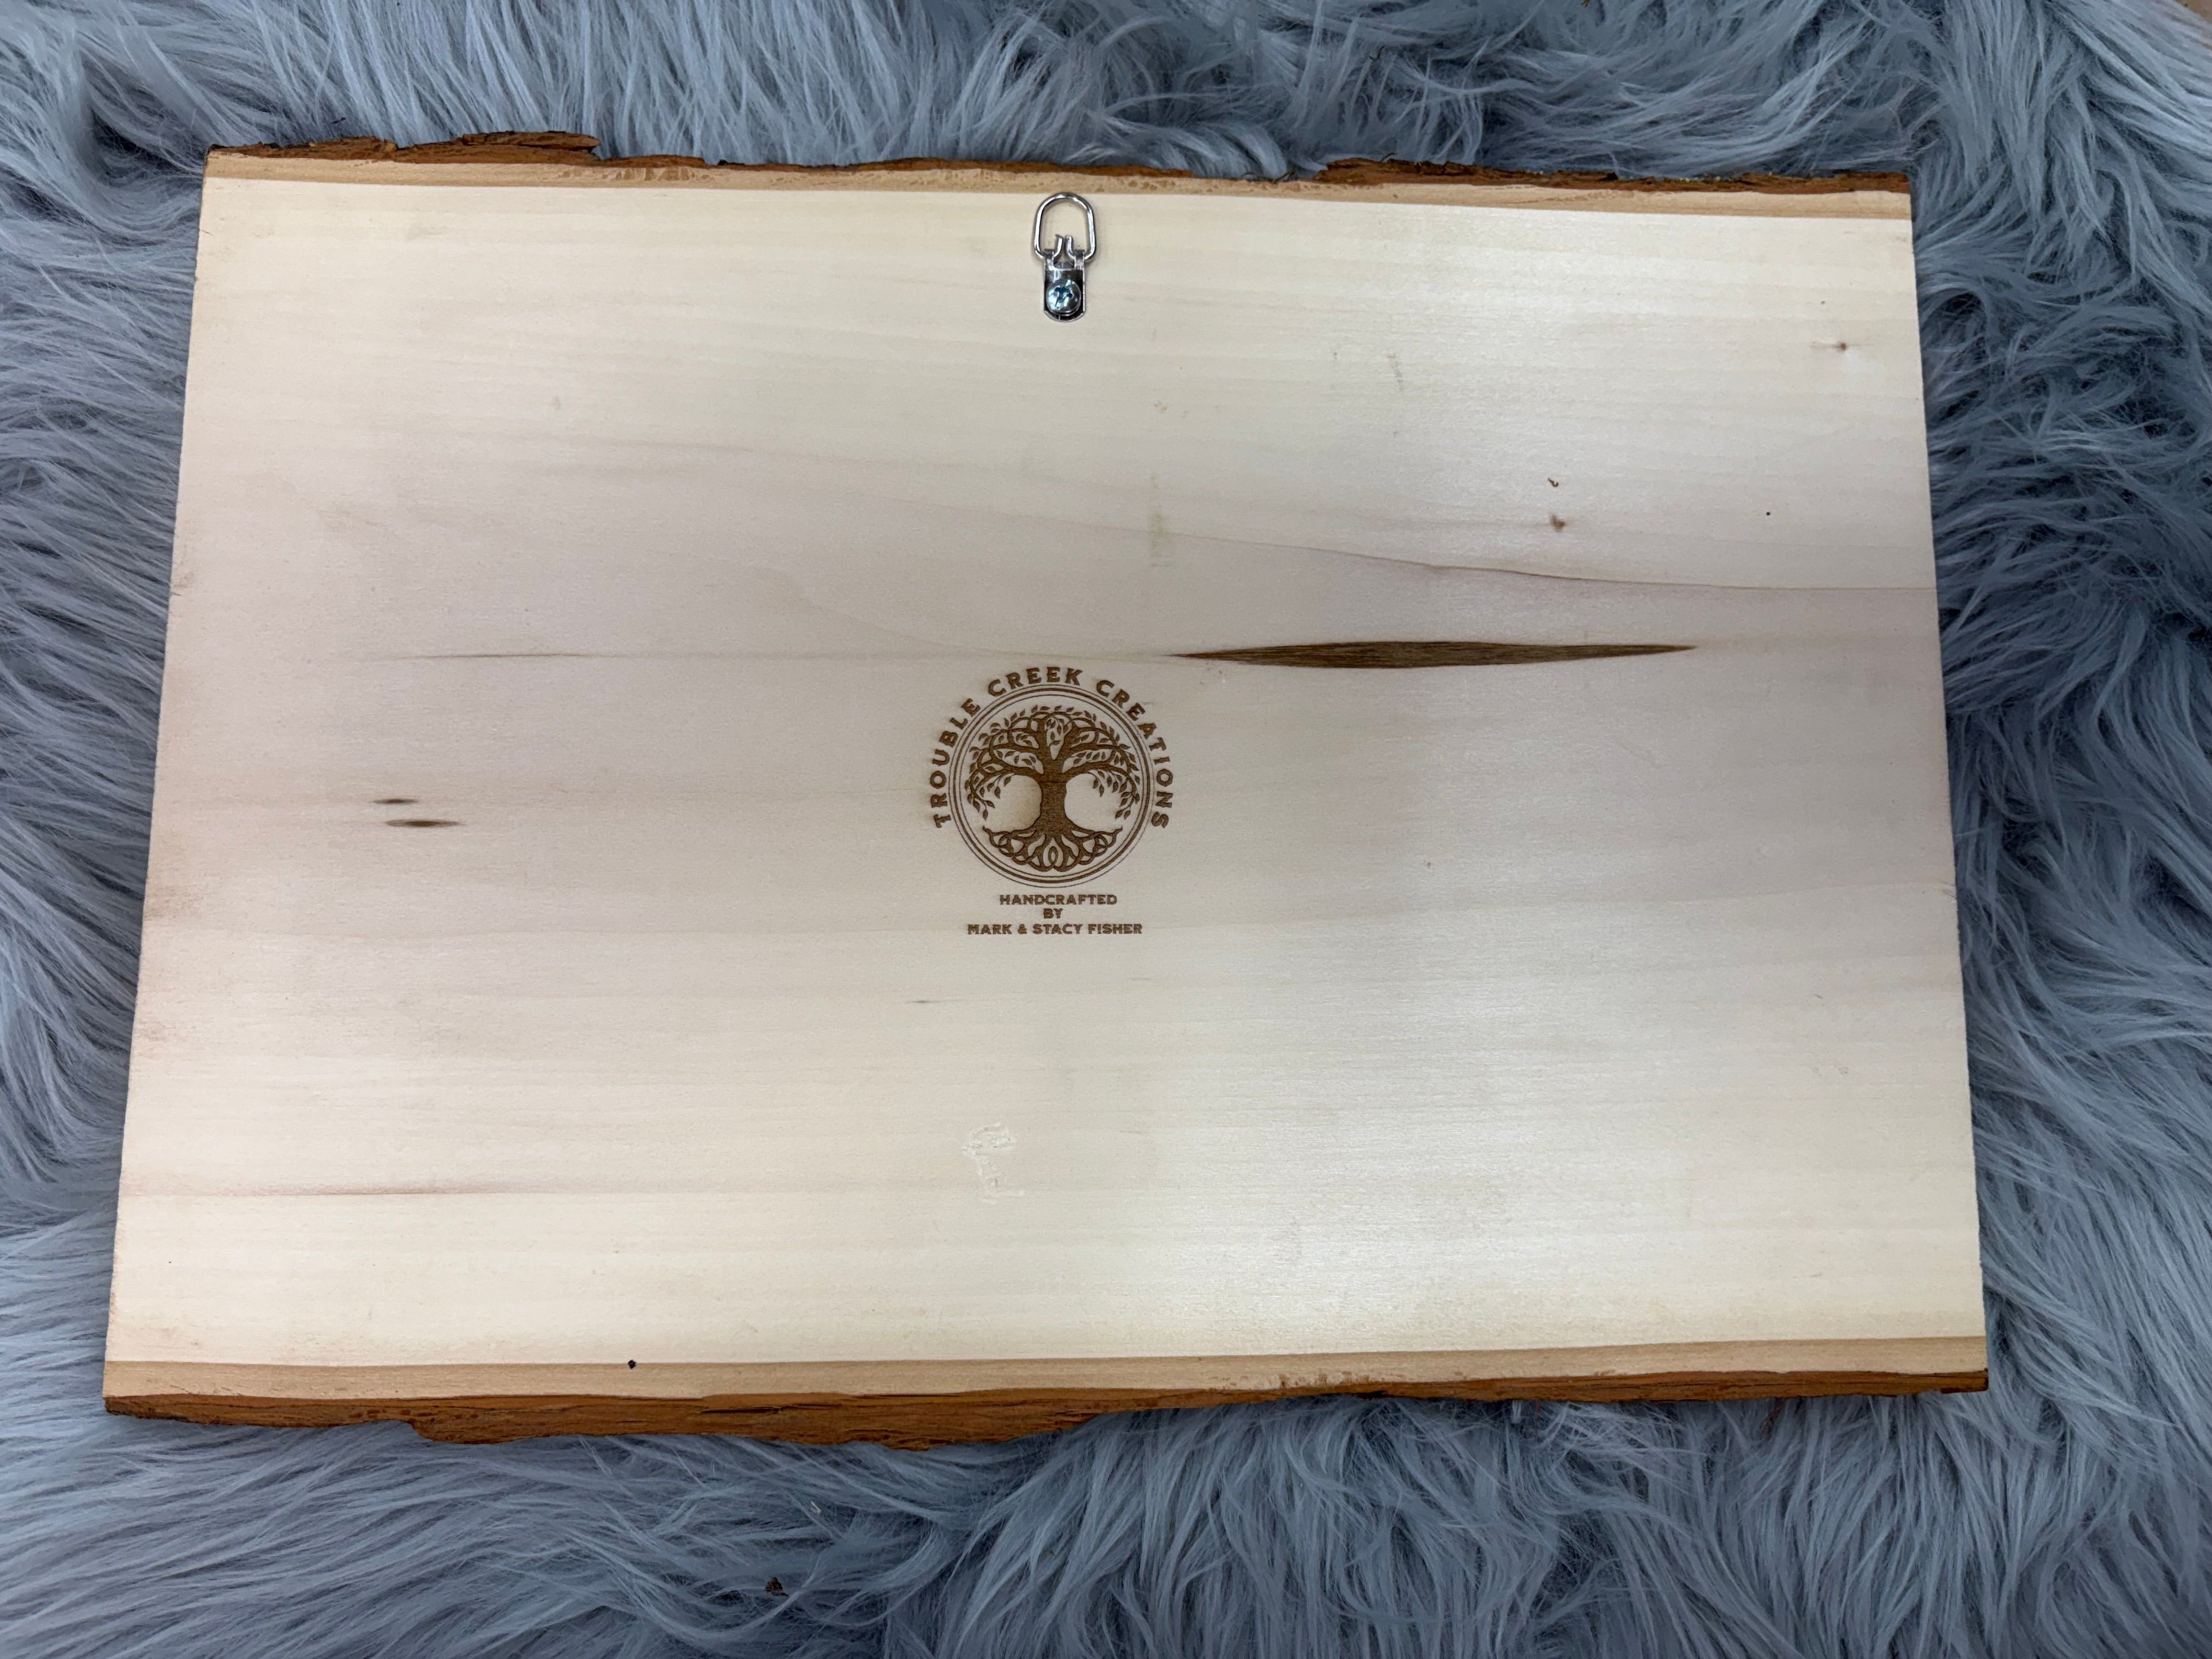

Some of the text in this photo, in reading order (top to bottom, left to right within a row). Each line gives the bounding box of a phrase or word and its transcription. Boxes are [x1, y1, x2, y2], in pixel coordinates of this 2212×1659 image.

[930, 666, 1174, 828] TROUBLE CREEK CREATIONS
[999, 894, 1118, 905] HANDCRAFTED
[1043, 908, 1063, 919] BY
[967, 923, 1142, 934] MARK & STACY FISHER
